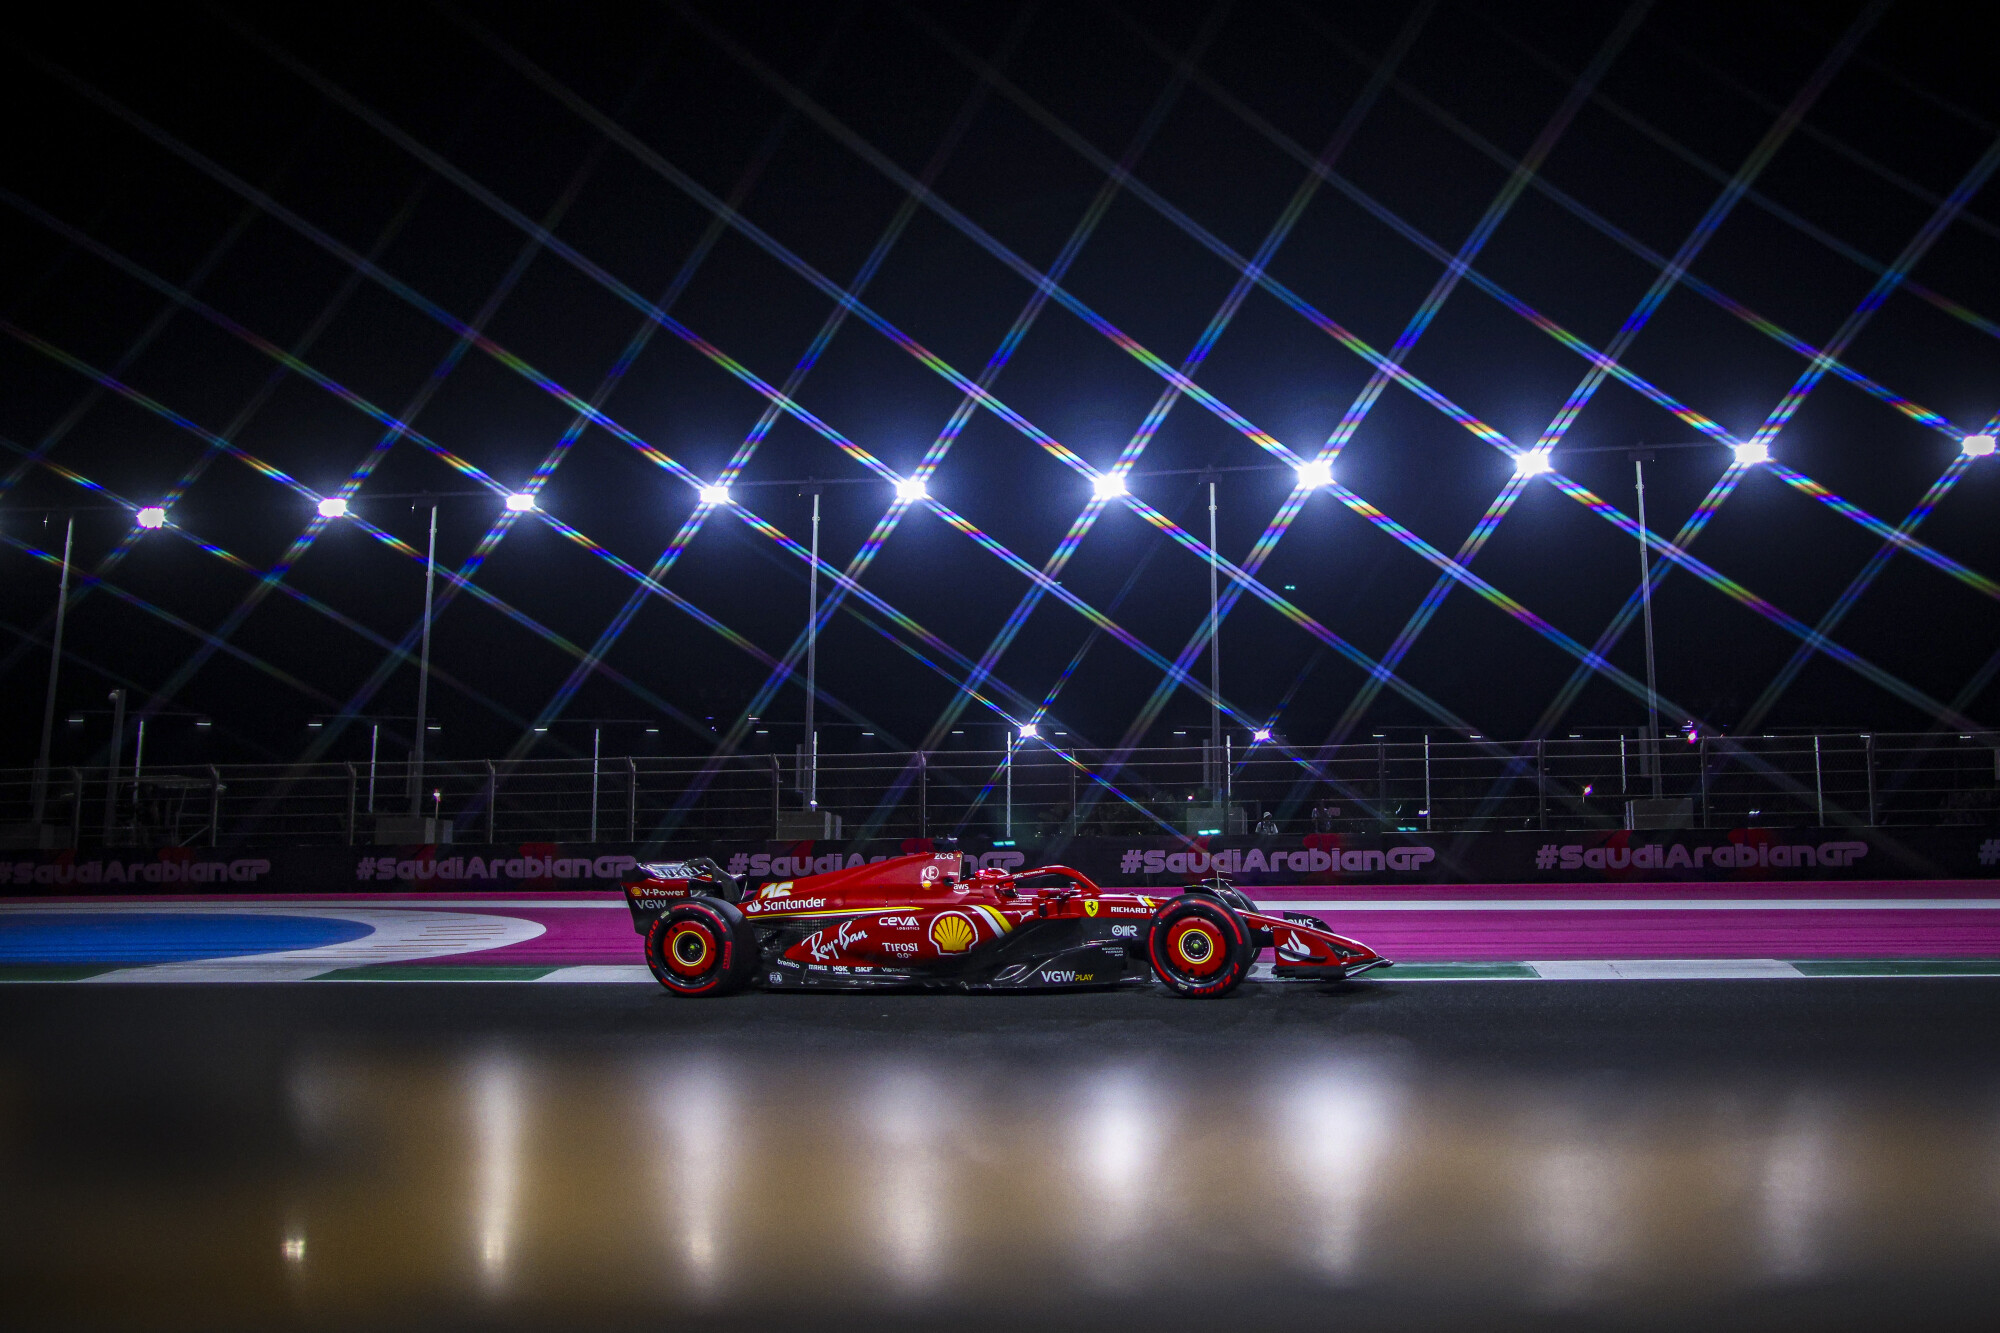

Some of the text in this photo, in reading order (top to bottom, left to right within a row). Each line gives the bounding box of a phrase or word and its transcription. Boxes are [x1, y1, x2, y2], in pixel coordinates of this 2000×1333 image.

[1120, 846, 1435, 874] #SaudiArabianGP
[1535, 841, 1869, 870] #SaudiArabianGP
[356, 855, 637, 880] #SaudiArabianGP
[641, 888, 685, 896] V-Power
[760, 881, 794, 899] 16
[635, 899, 667, 909] VGW
[763, 897, 827, 911] Santander
[1110, 906, 1147, 914] RICHARD
[882, 942, 919, 952] TIFOSI
[777, 958, 800, 969] brembo
[1041, 970, 1094, 982] VGW PLAY
